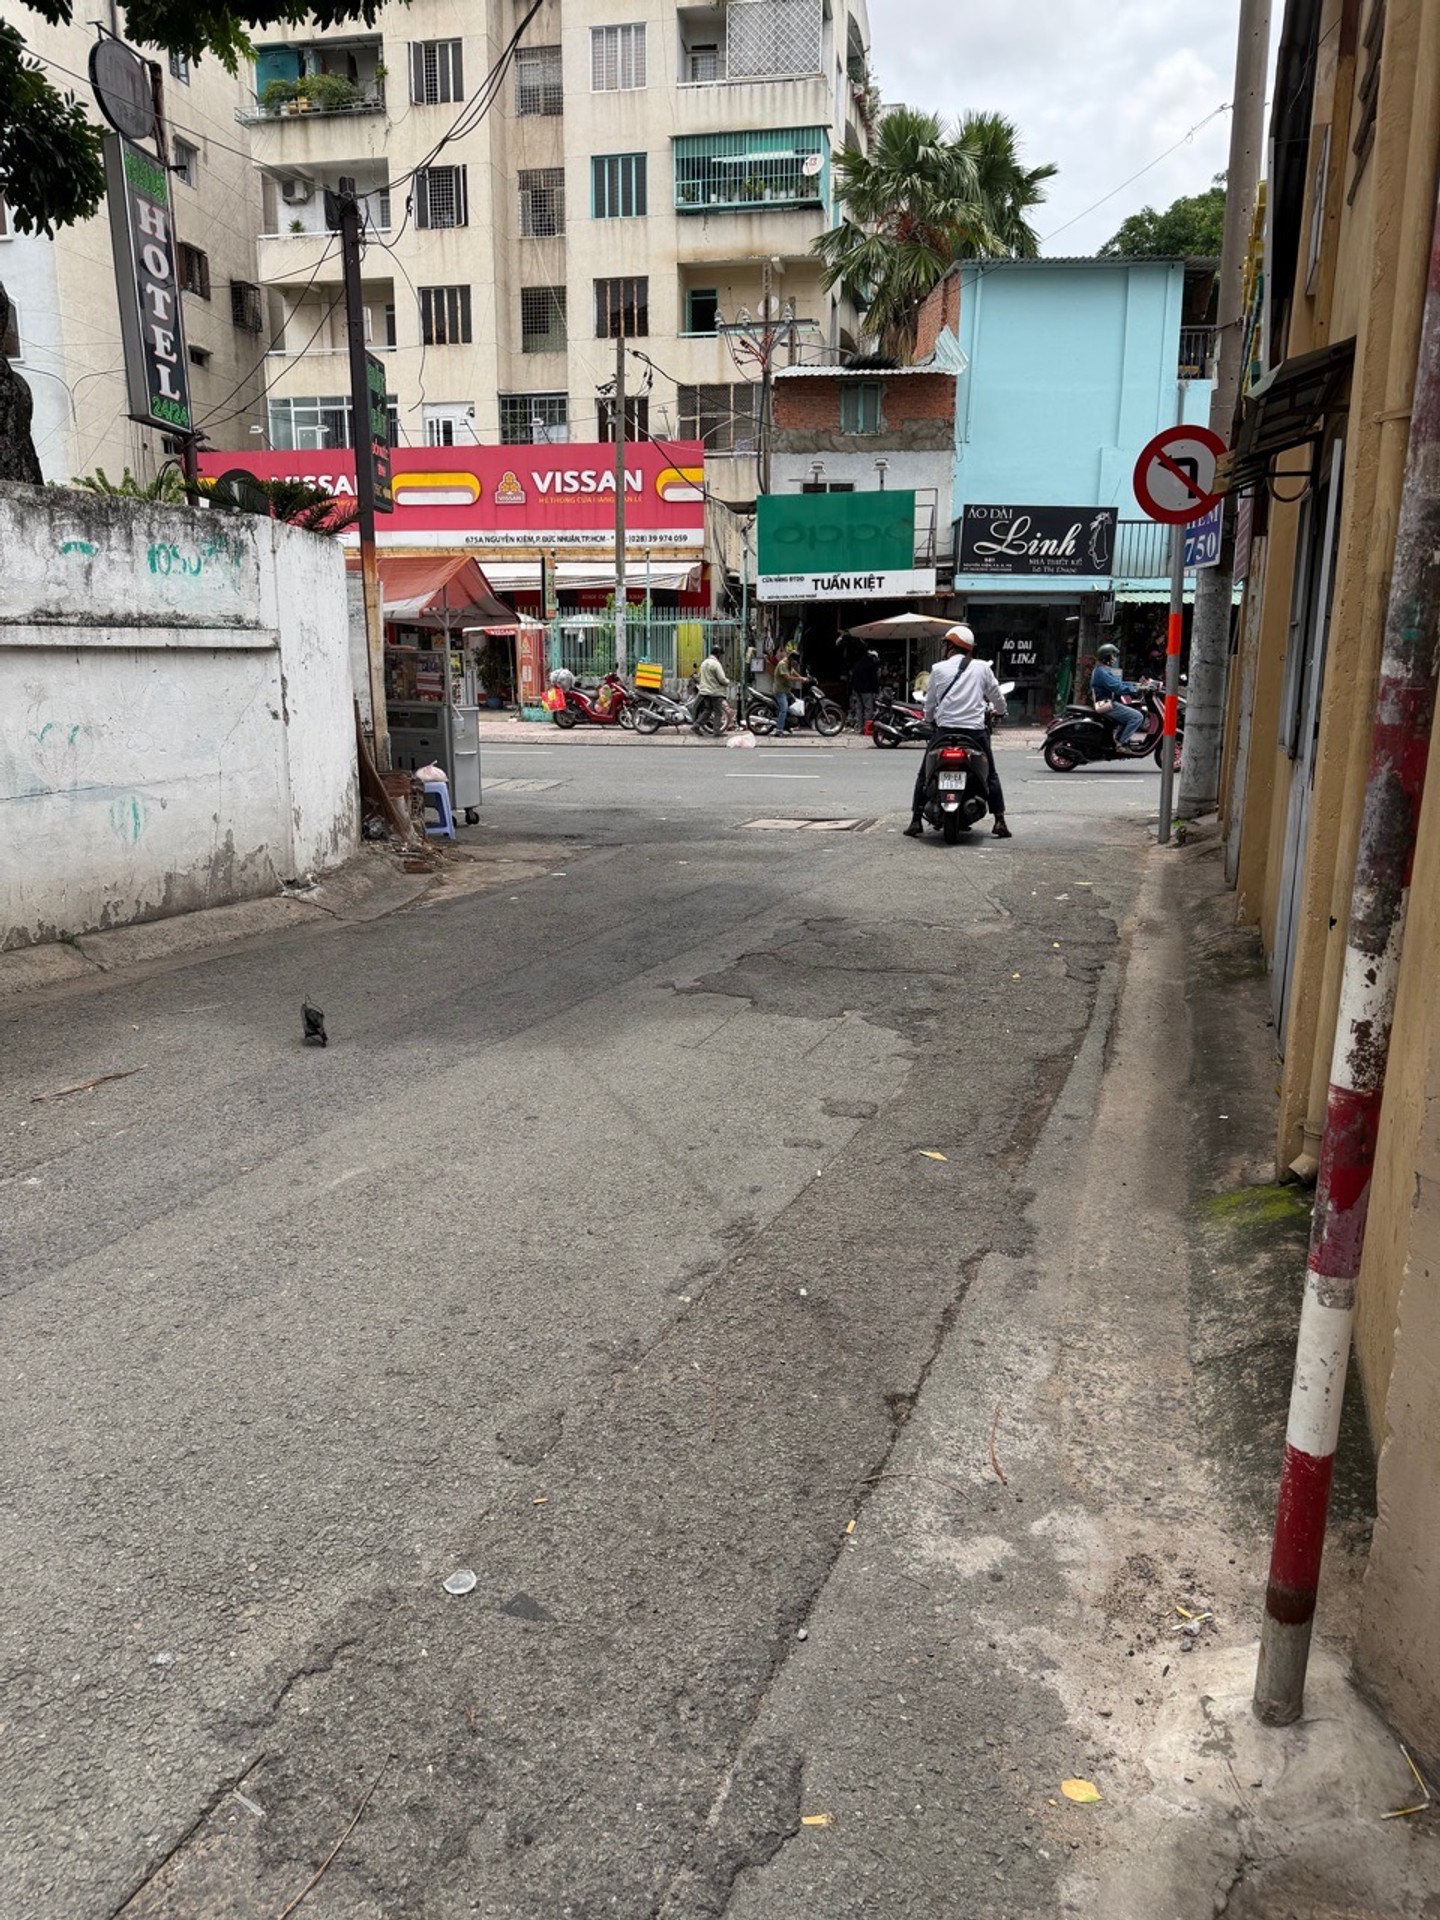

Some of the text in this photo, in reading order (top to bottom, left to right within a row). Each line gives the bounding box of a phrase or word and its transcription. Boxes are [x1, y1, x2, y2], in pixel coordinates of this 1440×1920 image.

[137, 198, 180, 401] HOTEL
[531, 469, 643, 494] VISSAN
[968, 505, 1013, 519] ÁO DÀI
[659, 534, 672, 542] 974
[674, 534, 688, 542] 059
[973, 516, 1083, 556] Linh
[1185, 532, 1216, 563] 750
[812, 573, 885, 592] TUẤN KIỆT
